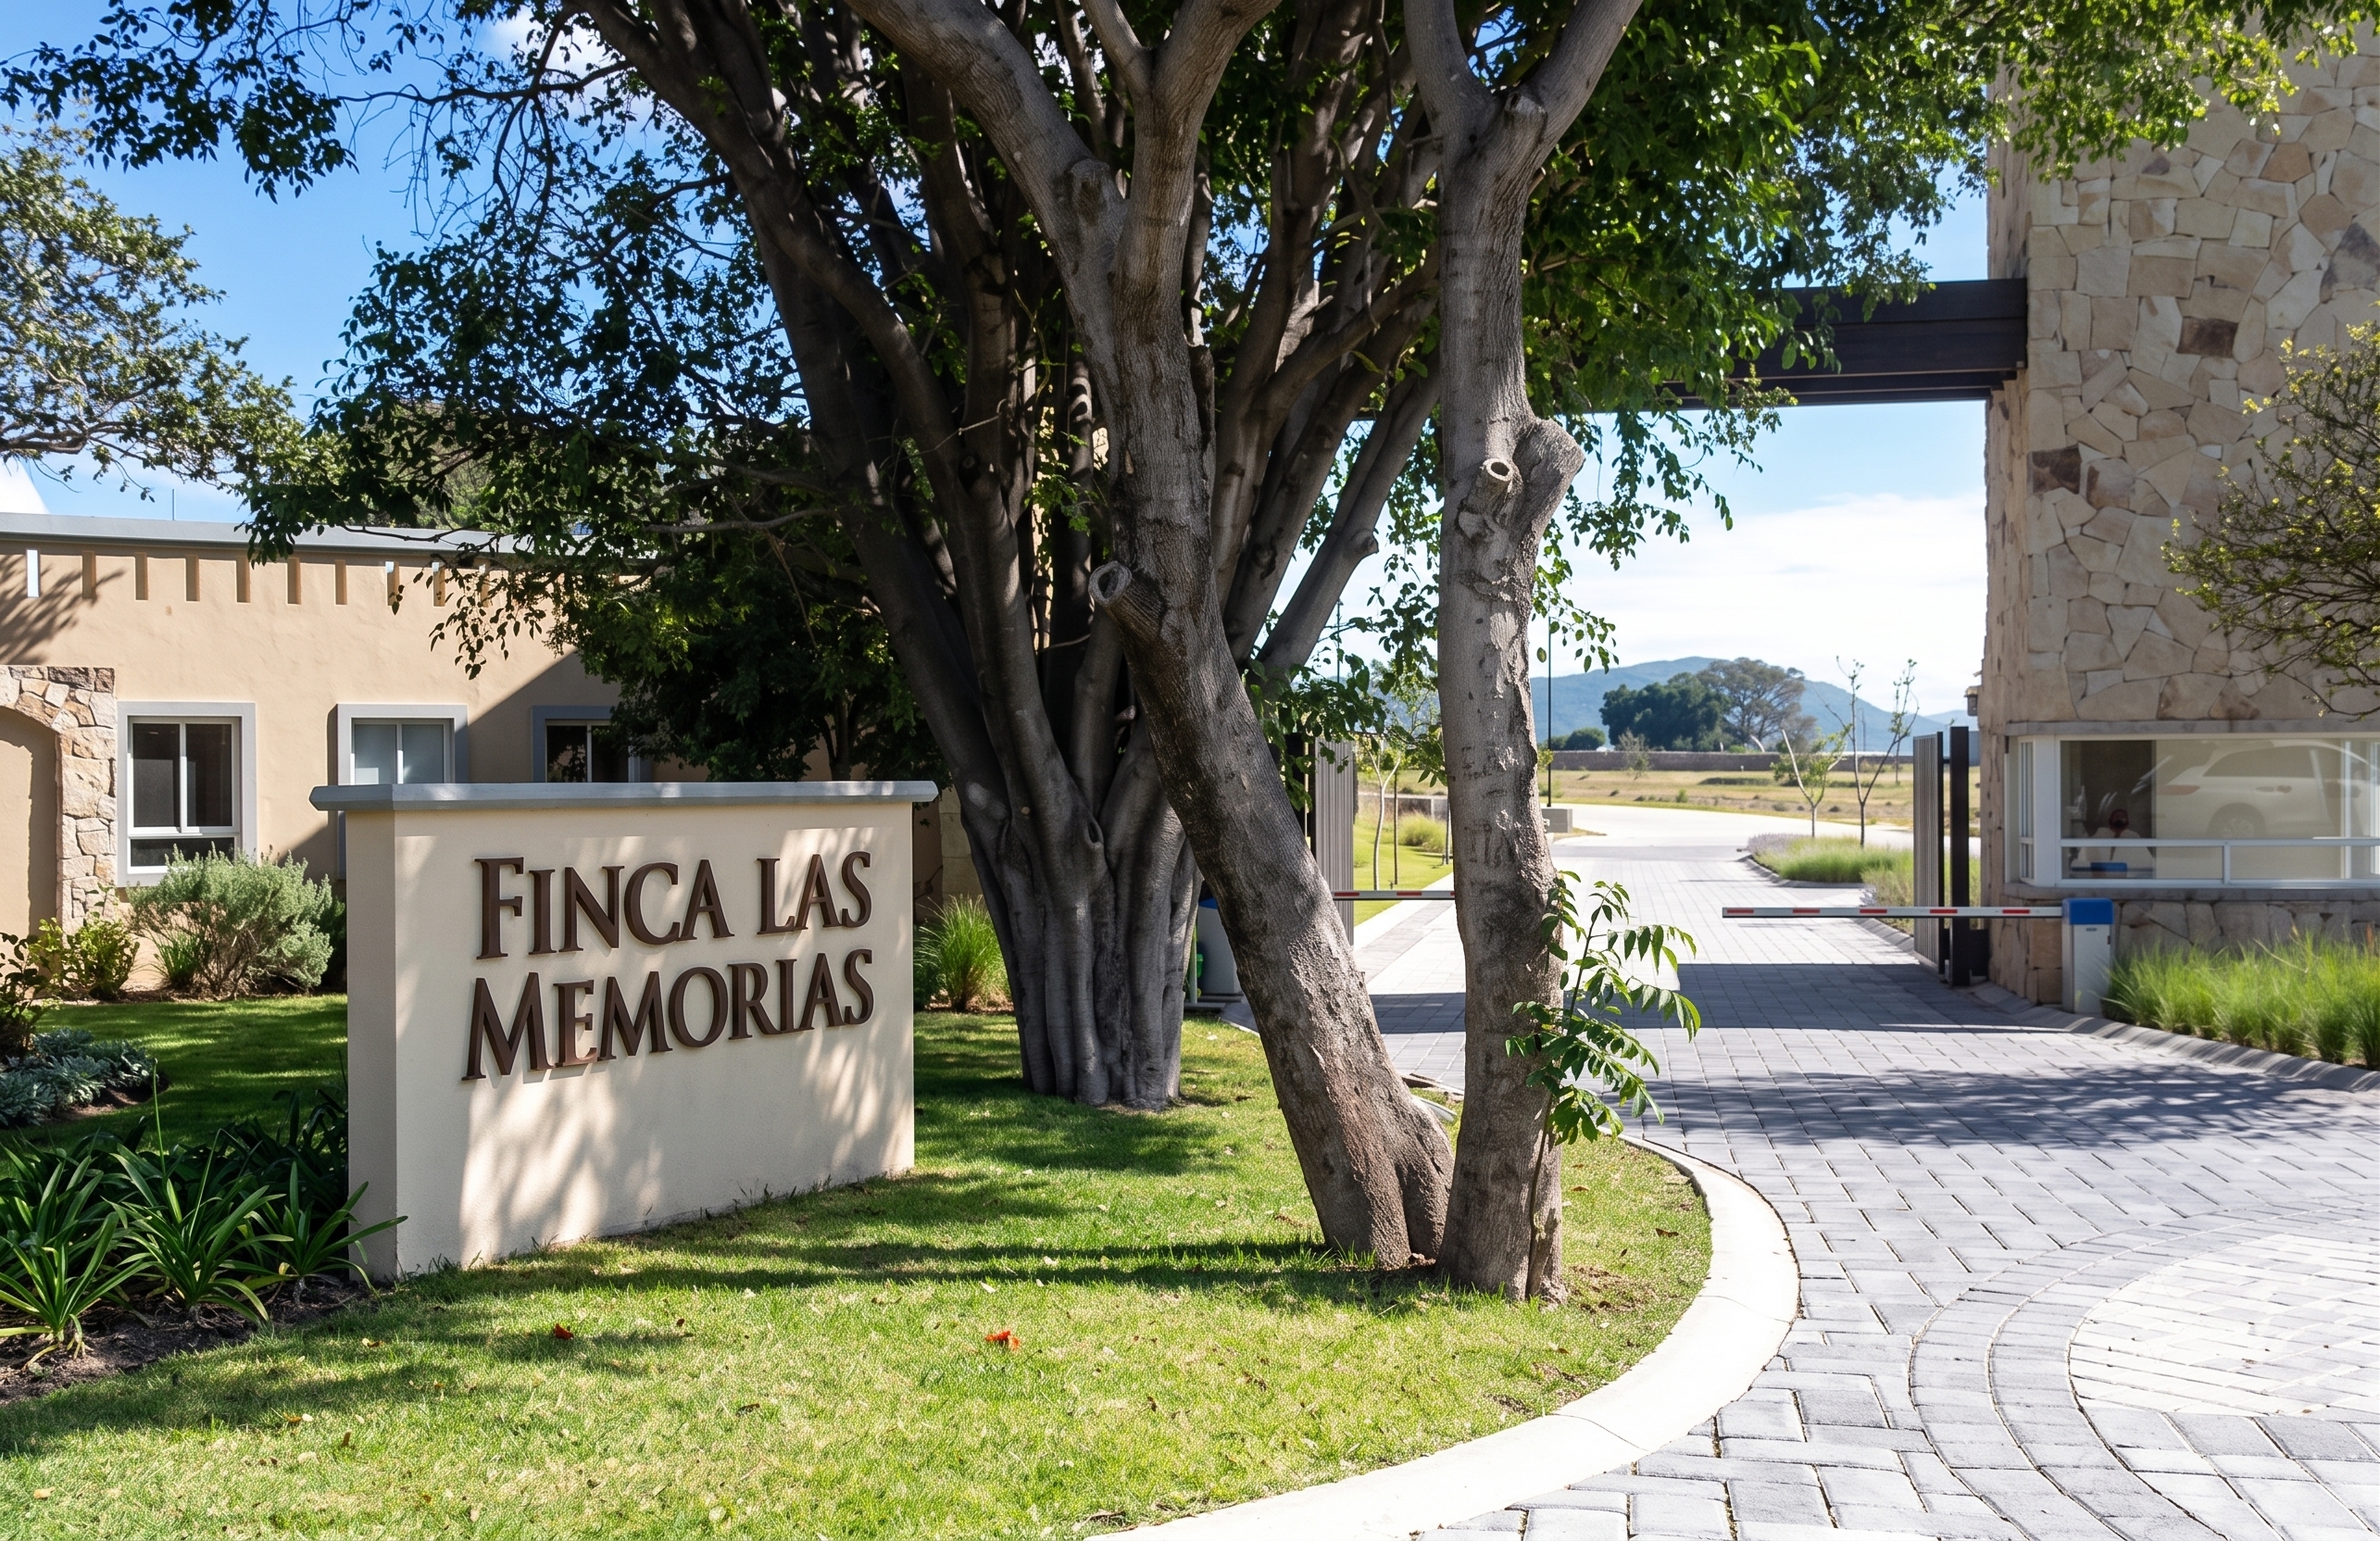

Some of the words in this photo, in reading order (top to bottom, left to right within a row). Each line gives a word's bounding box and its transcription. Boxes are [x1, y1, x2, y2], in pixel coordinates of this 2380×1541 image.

[474, 857, 734, 959] FINCA
[757, 851, 872, 935] LAS
[461, 948, 874, 1081] MEMORIAS
